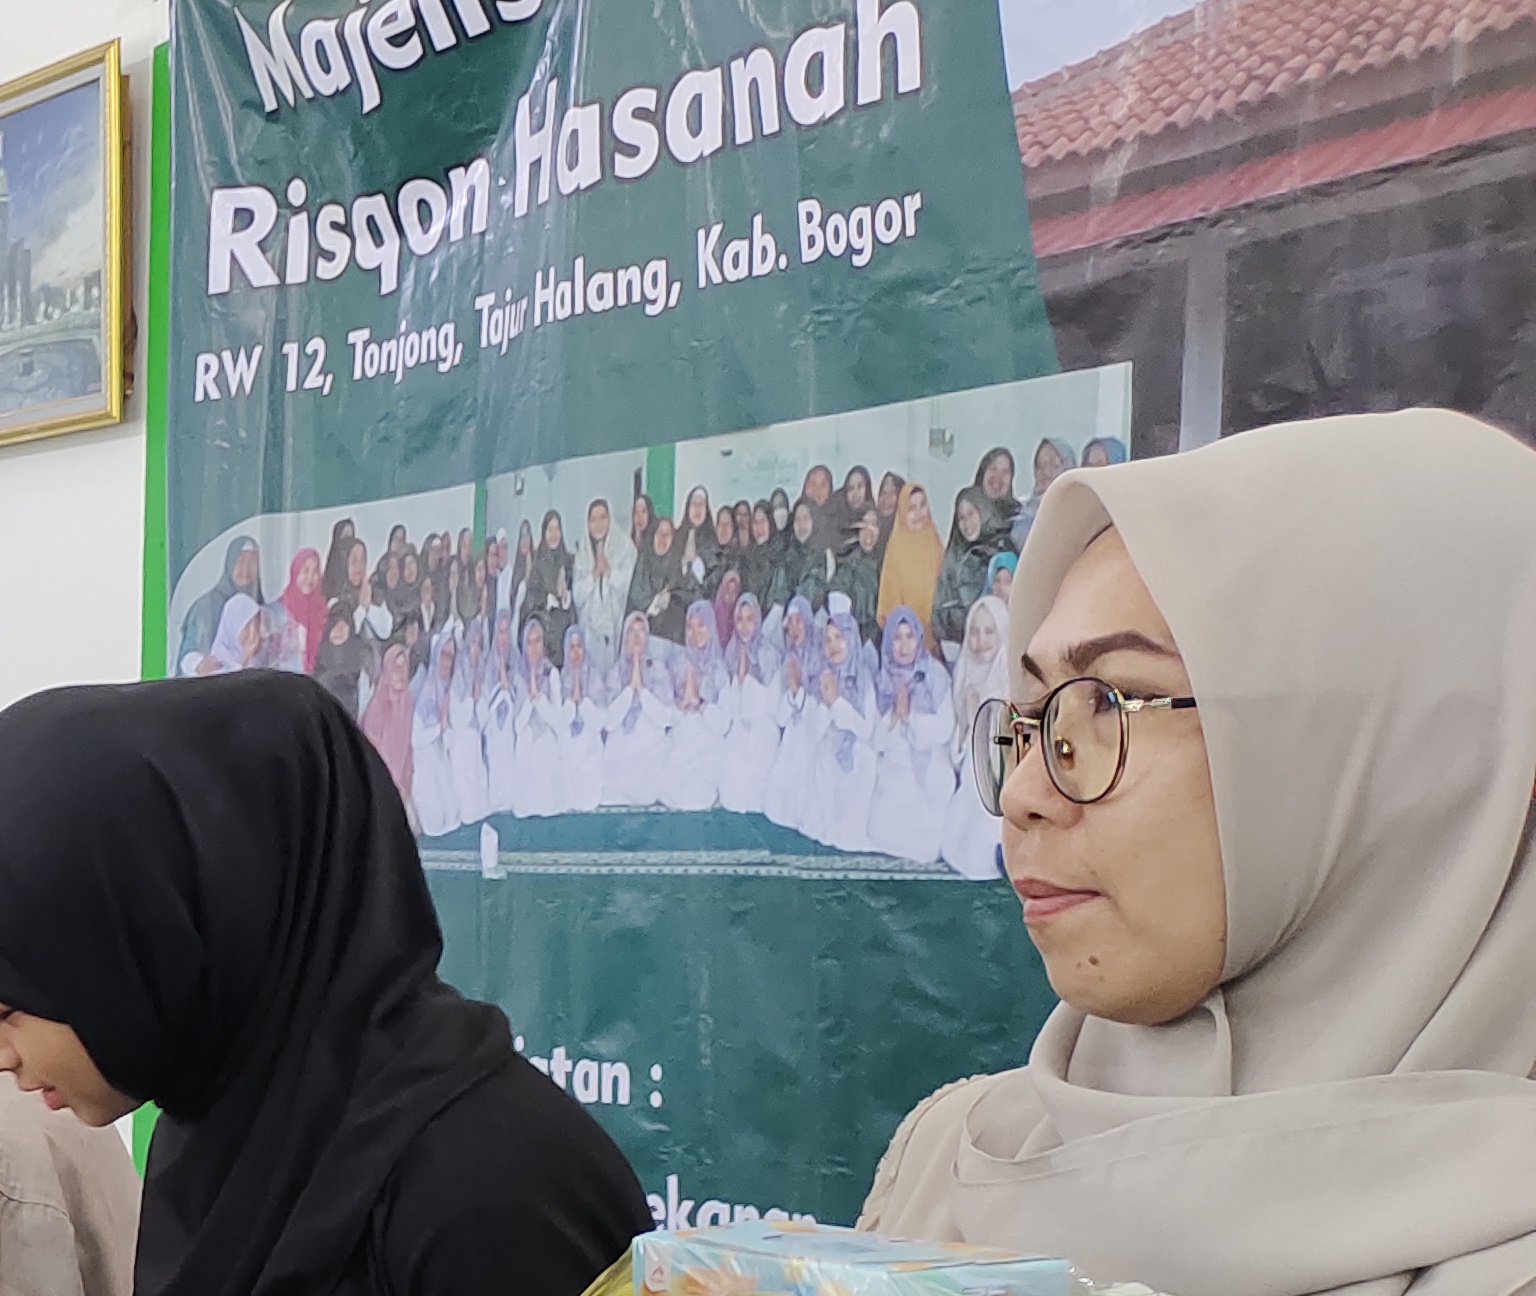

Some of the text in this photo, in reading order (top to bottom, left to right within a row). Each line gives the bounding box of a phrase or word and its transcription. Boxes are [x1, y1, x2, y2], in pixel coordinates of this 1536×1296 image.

[207, 0, 922, 296] Risqon Hasanah
[194, 191, 924, 402] RW 12, Tonjong, Tajur Halang, Kab. Bogor
[513, 1034, 631, 1106] tan
